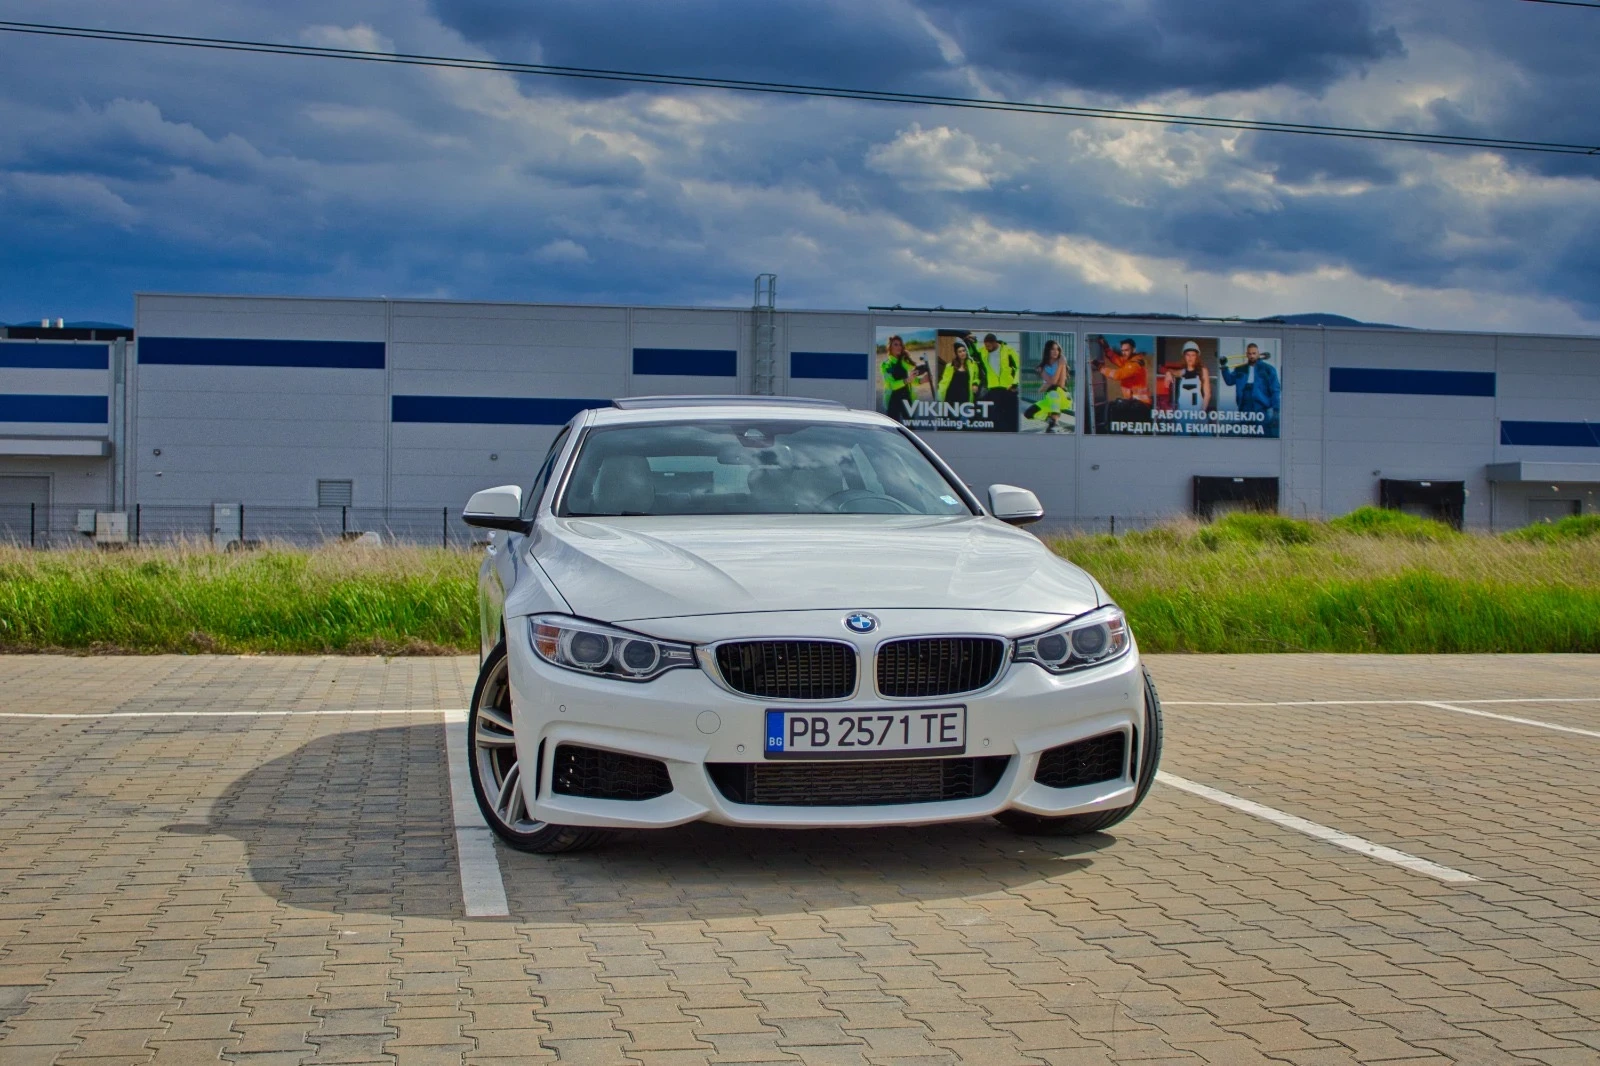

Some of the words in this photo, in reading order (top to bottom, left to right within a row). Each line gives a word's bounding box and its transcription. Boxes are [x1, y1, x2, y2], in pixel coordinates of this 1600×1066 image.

[902, 399, 994, 418] VIKING-T
[1151, 409, 1207, 420] РАБОТНО
[1209, 411, 1265, 422] ОБЛЕКЛО
[903, 418, 994, 429] www.viking-t.com
[1111, 421, 1183, 433] ПРЕДПАЗНА
[1186, 423, 1265, 435] ЕКИПИРОВКА
[789, 717, 830, 747] PB
[837, 715, 909, 746] 2571
[920, 713, 958, 743] TE
[769, 737, 783, 746] BG
